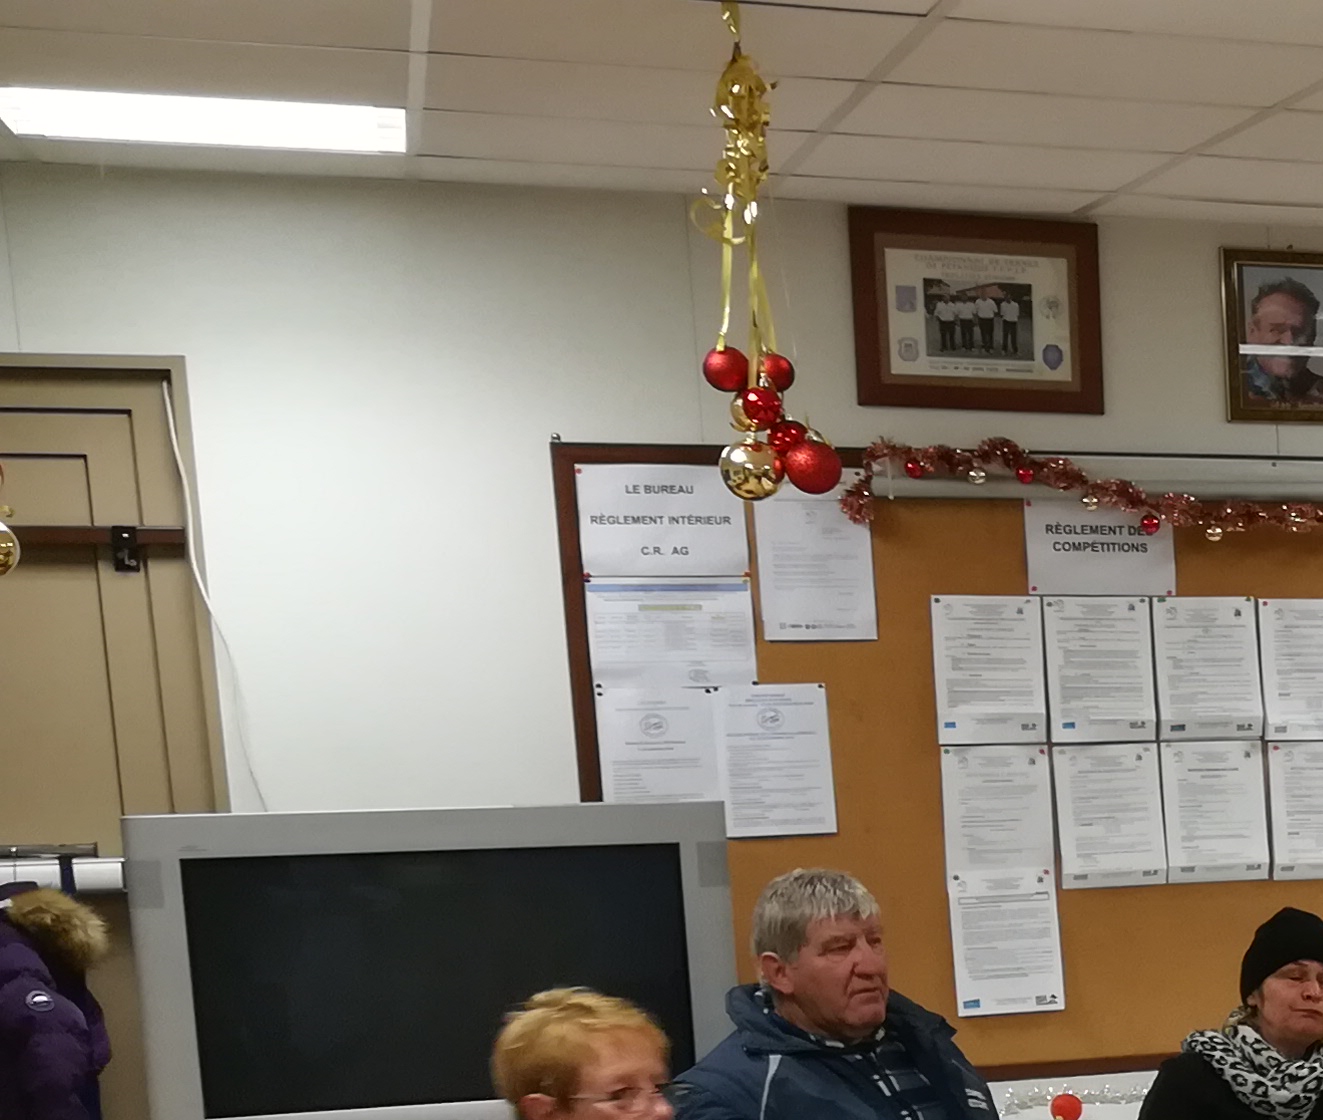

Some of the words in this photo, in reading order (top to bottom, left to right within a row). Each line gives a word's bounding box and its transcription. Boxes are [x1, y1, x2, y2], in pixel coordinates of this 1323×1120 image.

[625, 484, 642, 495] LE
[644, 484, 694, 495] BUREAU
[590, 513, 664, 525] RÈGLEMENT
[667, 513, 732, 526] INTÉRIEUR
[1045, 521, 1125, 536] RÈGLEMENT
[1128, 525, 1149, 536] DE
[671, 546, 690, 556] AG
[1052, 540, 1149, 553] COMPÉTITIONS
